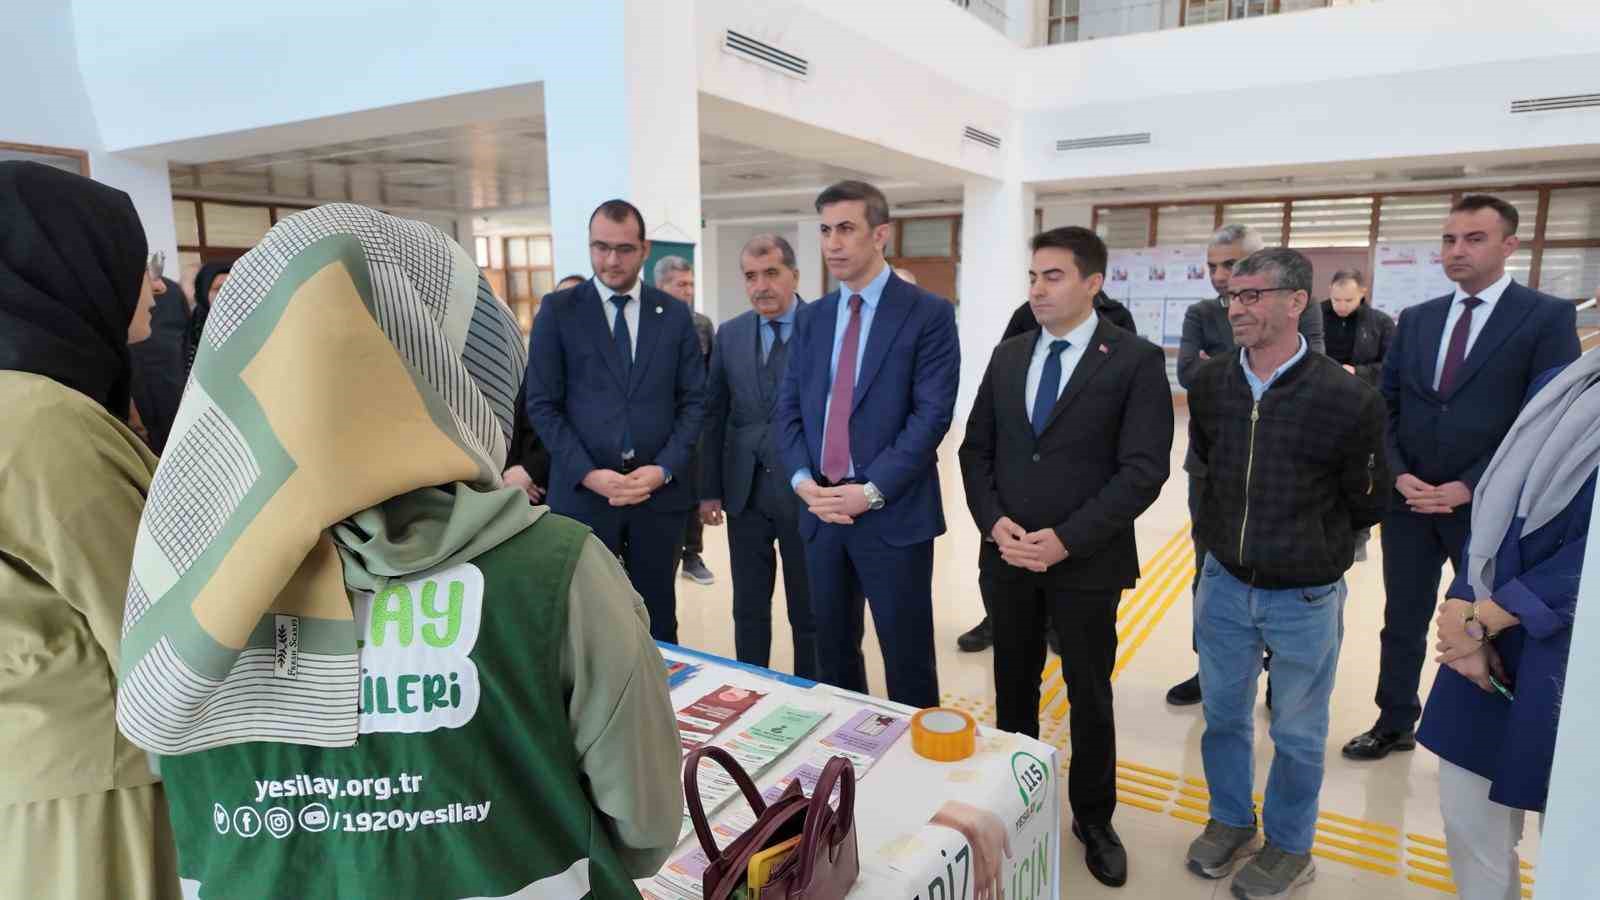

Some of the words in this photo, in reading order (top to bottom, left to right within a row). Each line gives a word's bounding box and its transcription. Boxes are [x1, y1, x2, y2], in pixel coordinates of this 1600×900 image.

[255, 773, 423, 802] yesilay.org.tr
[1021, 763, 1044, 793] 115
[332, 801, 491, 833] /1920yesilay
